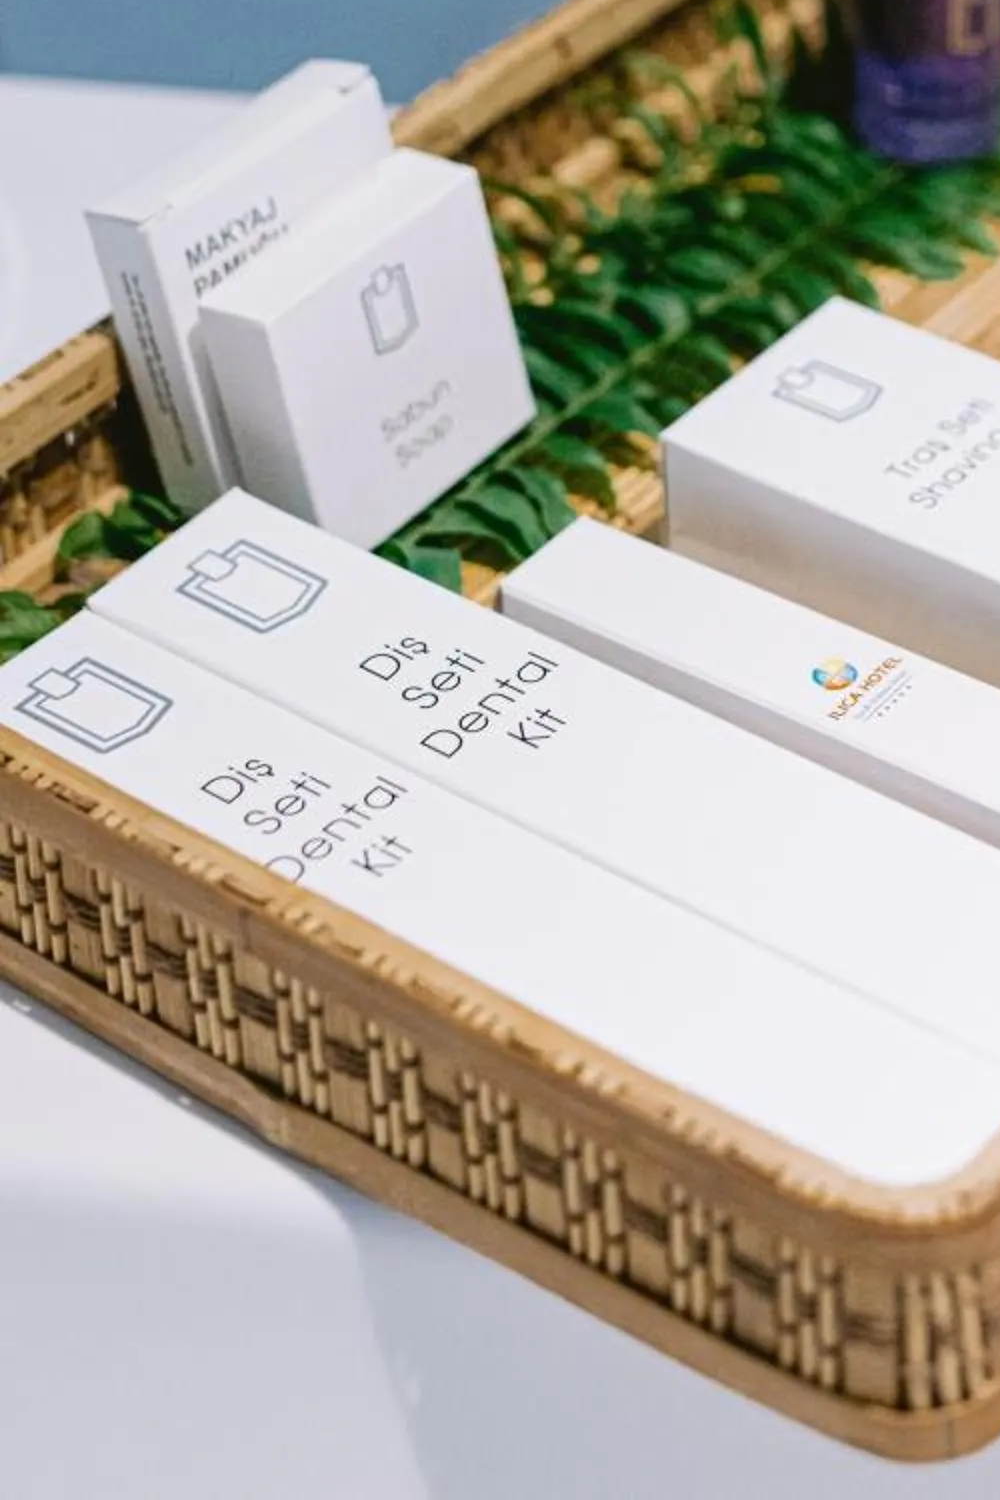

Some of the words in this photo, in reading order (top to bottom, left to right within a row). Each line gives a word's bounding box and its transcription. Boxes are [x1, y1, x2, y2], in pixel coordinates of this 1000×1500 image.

[185, 197, 277, 270] MAKYAJ
[359, 634, 429, 680] Diş
[402, 648, 484, 709] Seti
[420, 651, 558, 758] Dental
[507, 707, 567, 749] Kit
[201, 756, 274, 804] Diş
[244, 771, 331, 835] Seti
[264, 776, 409, 884] Dental
[351, 834, 412, 877] Kit
